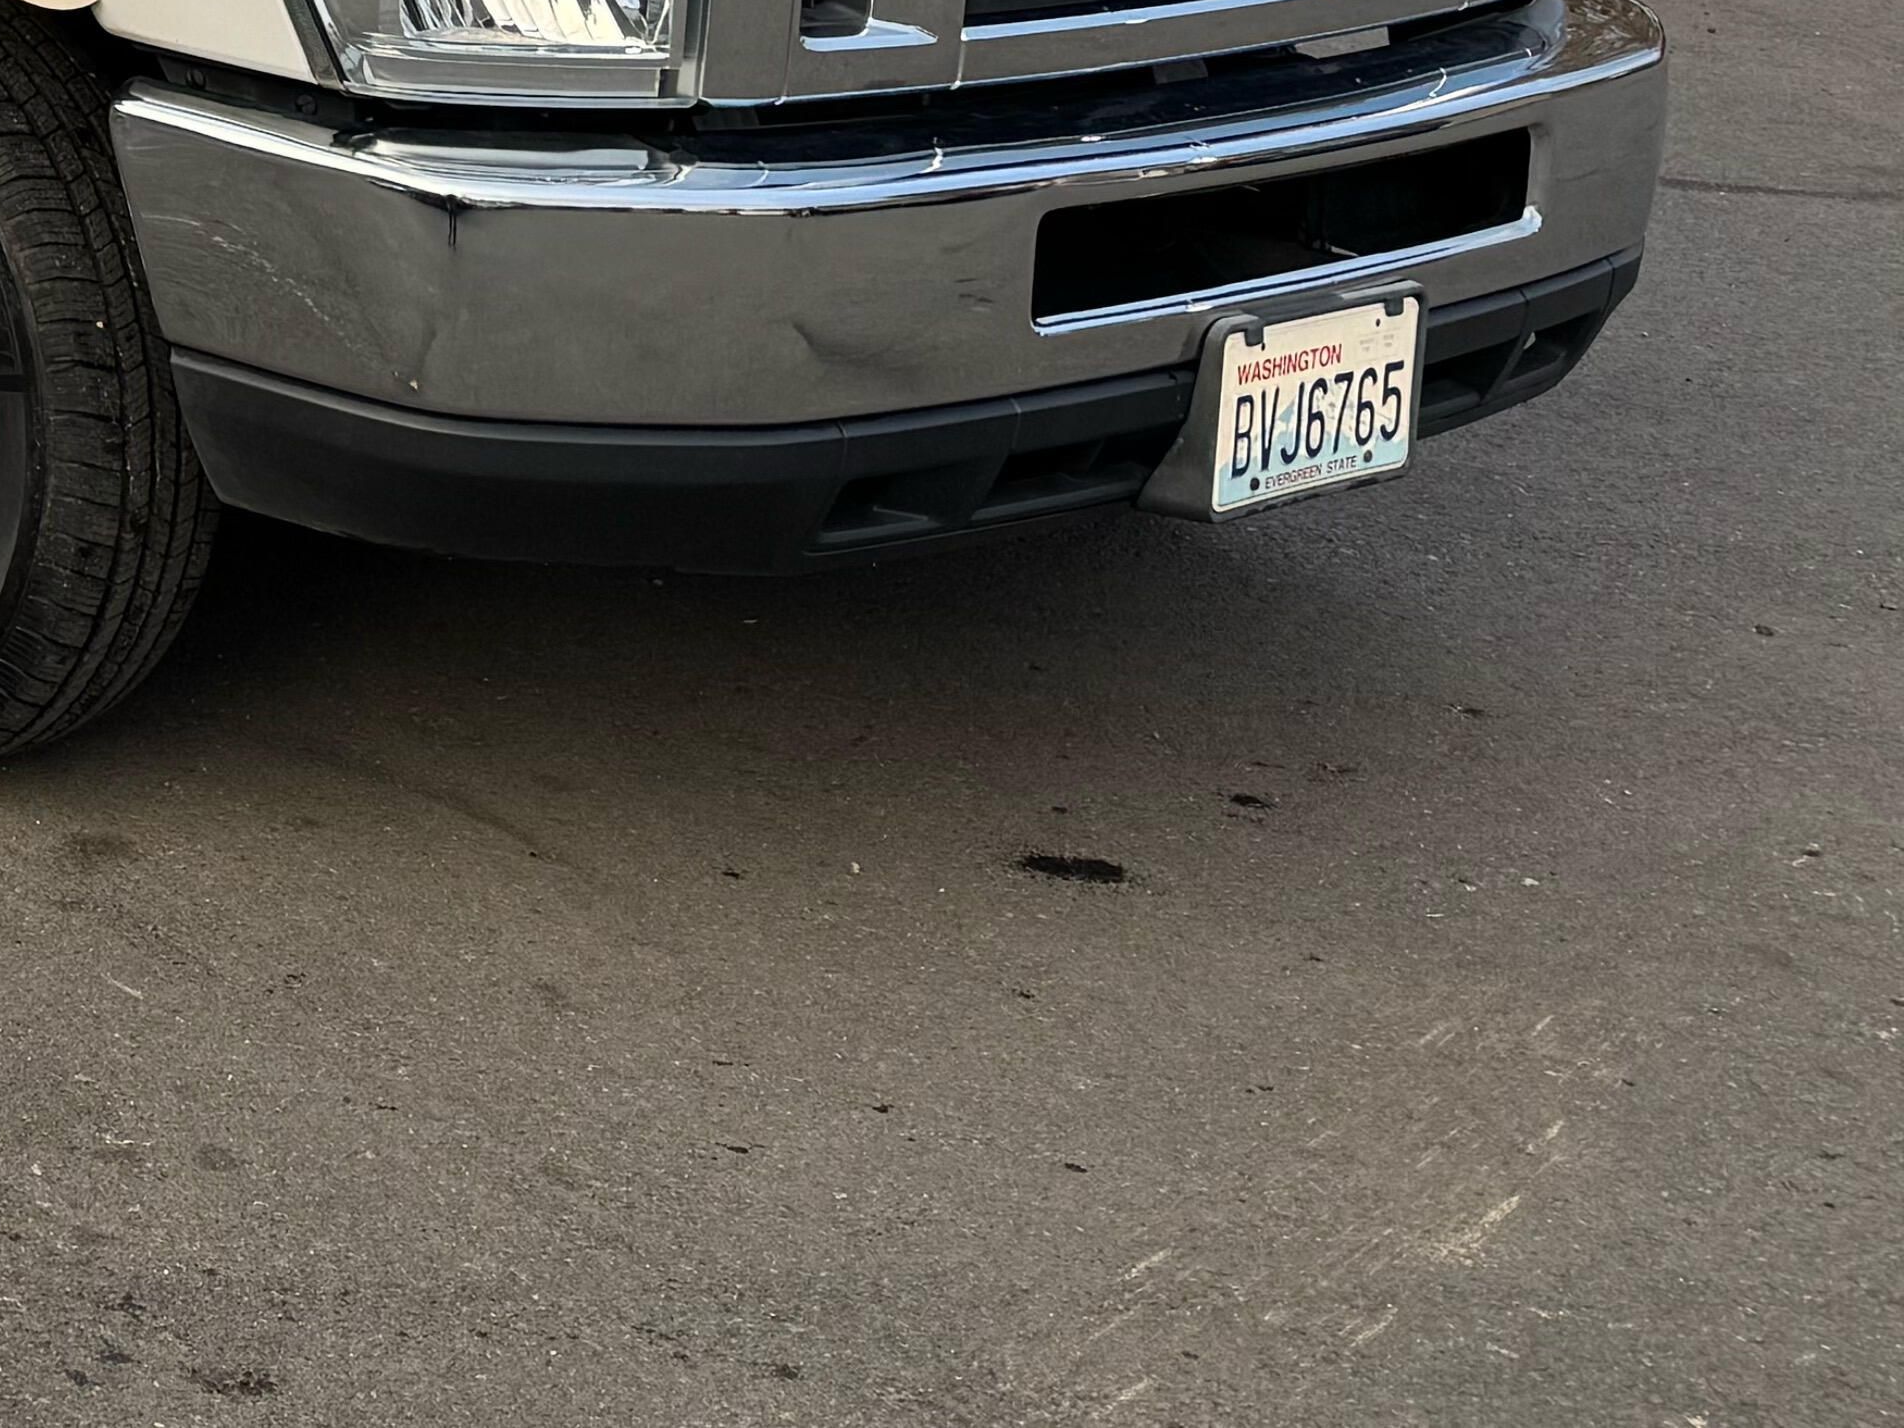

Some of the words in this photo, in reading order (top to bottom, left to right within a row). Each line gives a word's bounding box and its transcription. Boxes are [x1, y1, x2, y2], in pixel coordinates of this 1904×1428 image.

[1237, 344, 1342, 385] WASHINGTON
[1231, 360, 1405, 480] BVJ6765
[1265, 464, 1323, 489] EVERGREEN
[1326, 455, 1358, 474] STATE
